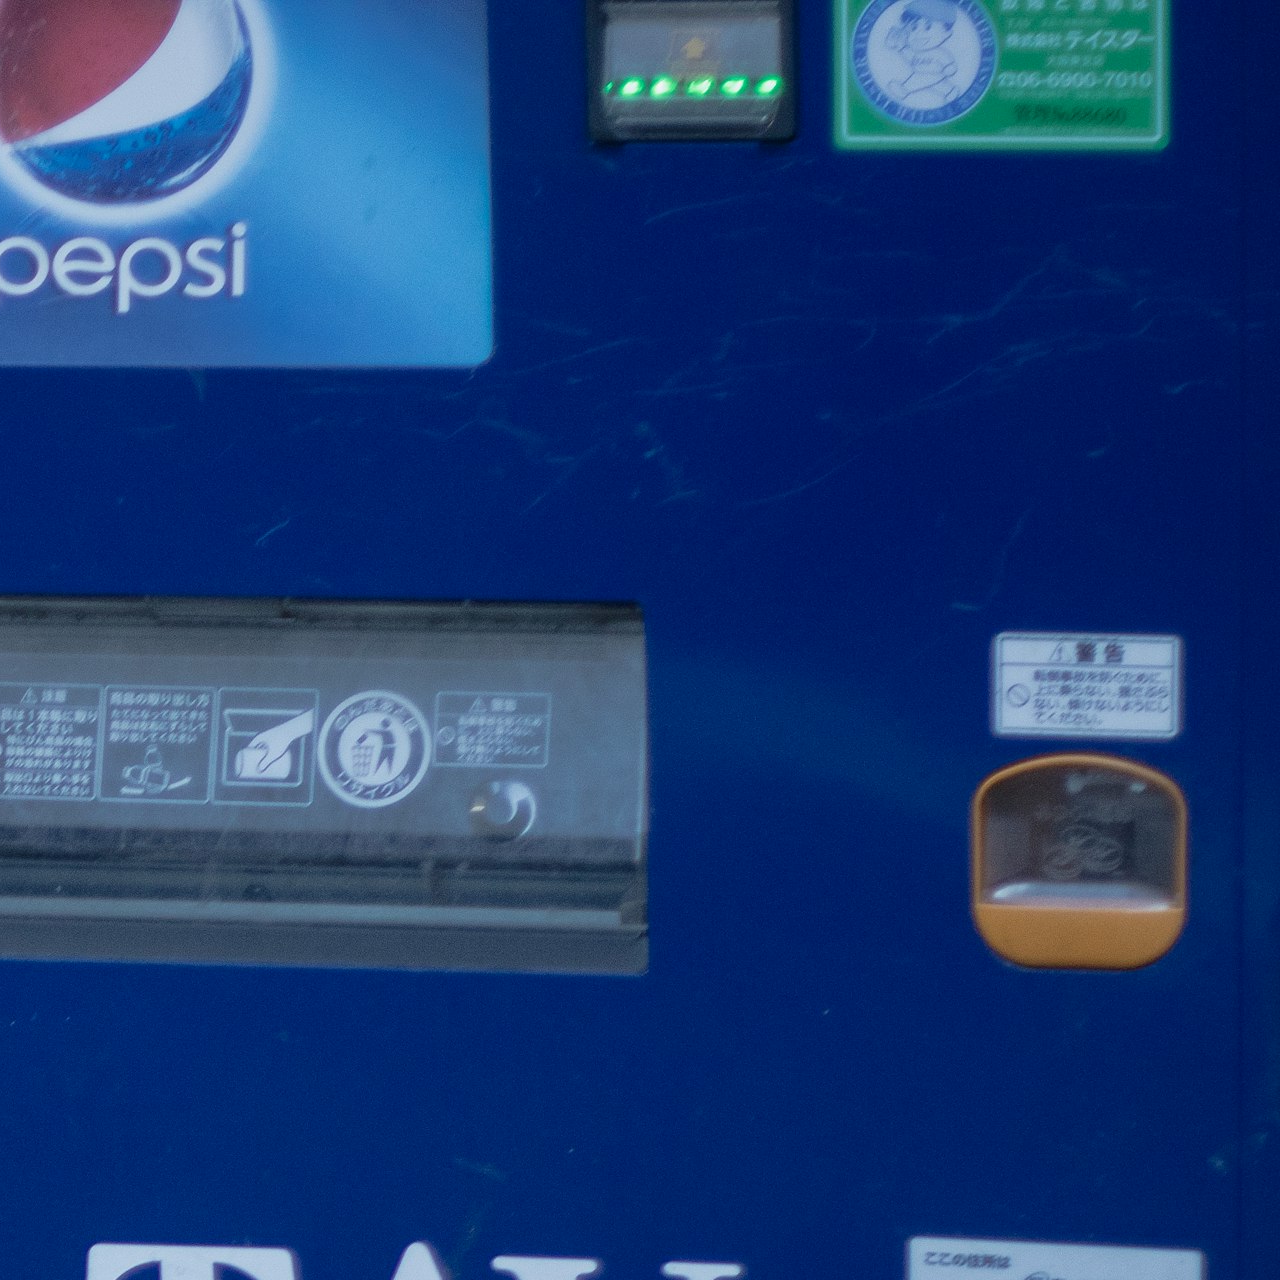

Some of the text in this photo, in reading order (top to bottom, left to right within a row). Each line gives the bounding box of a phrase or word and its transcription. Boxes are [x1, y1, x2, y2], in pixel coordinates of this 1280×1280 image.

[924, 1250, 1012, 1269] ここの住所は
